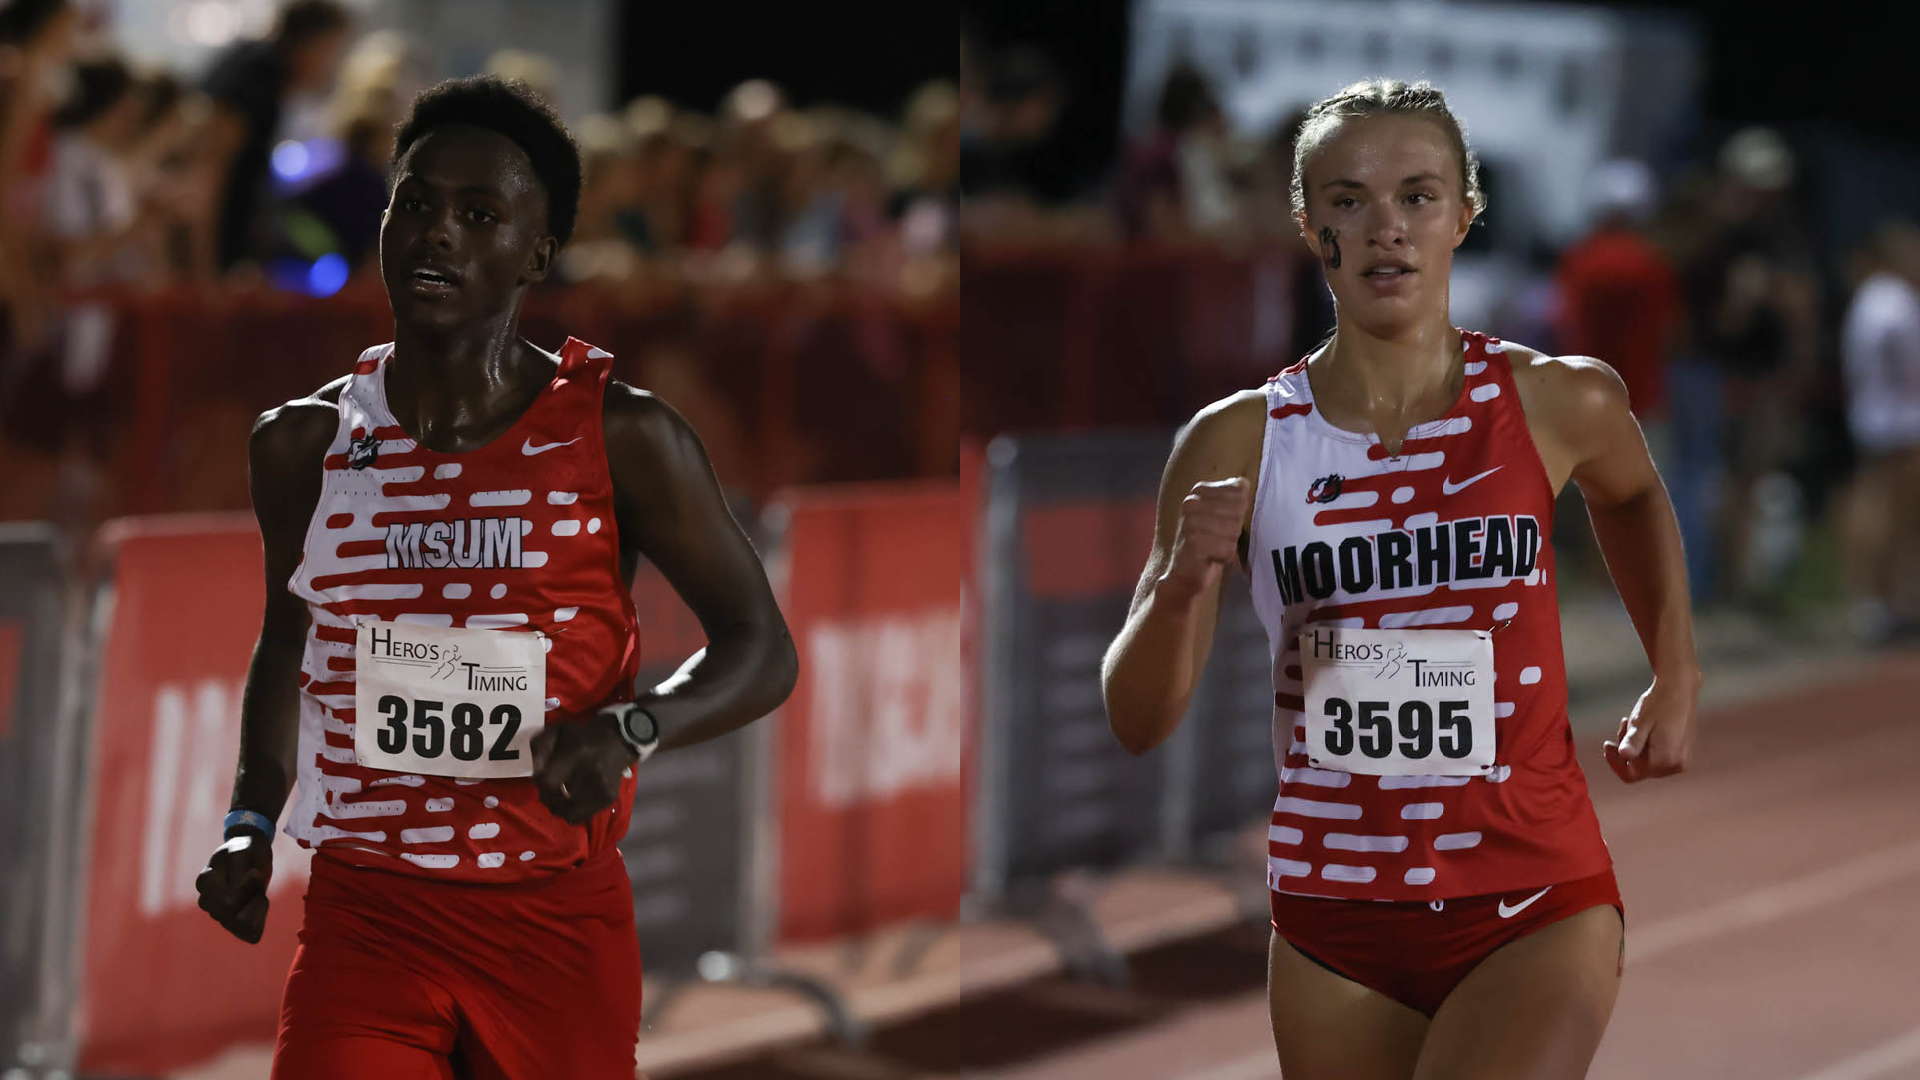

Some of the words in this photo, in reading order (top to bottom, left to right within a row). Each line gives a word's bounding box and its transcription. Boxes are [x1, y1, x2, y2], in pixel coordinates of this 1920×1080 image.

[386, 516, 523, 570] MSUM
[1271, 515, 1539, 607] MOORHEAD
[376, 694, 523, 761] 3582
[1323, 697, 1473, 760] 3595
